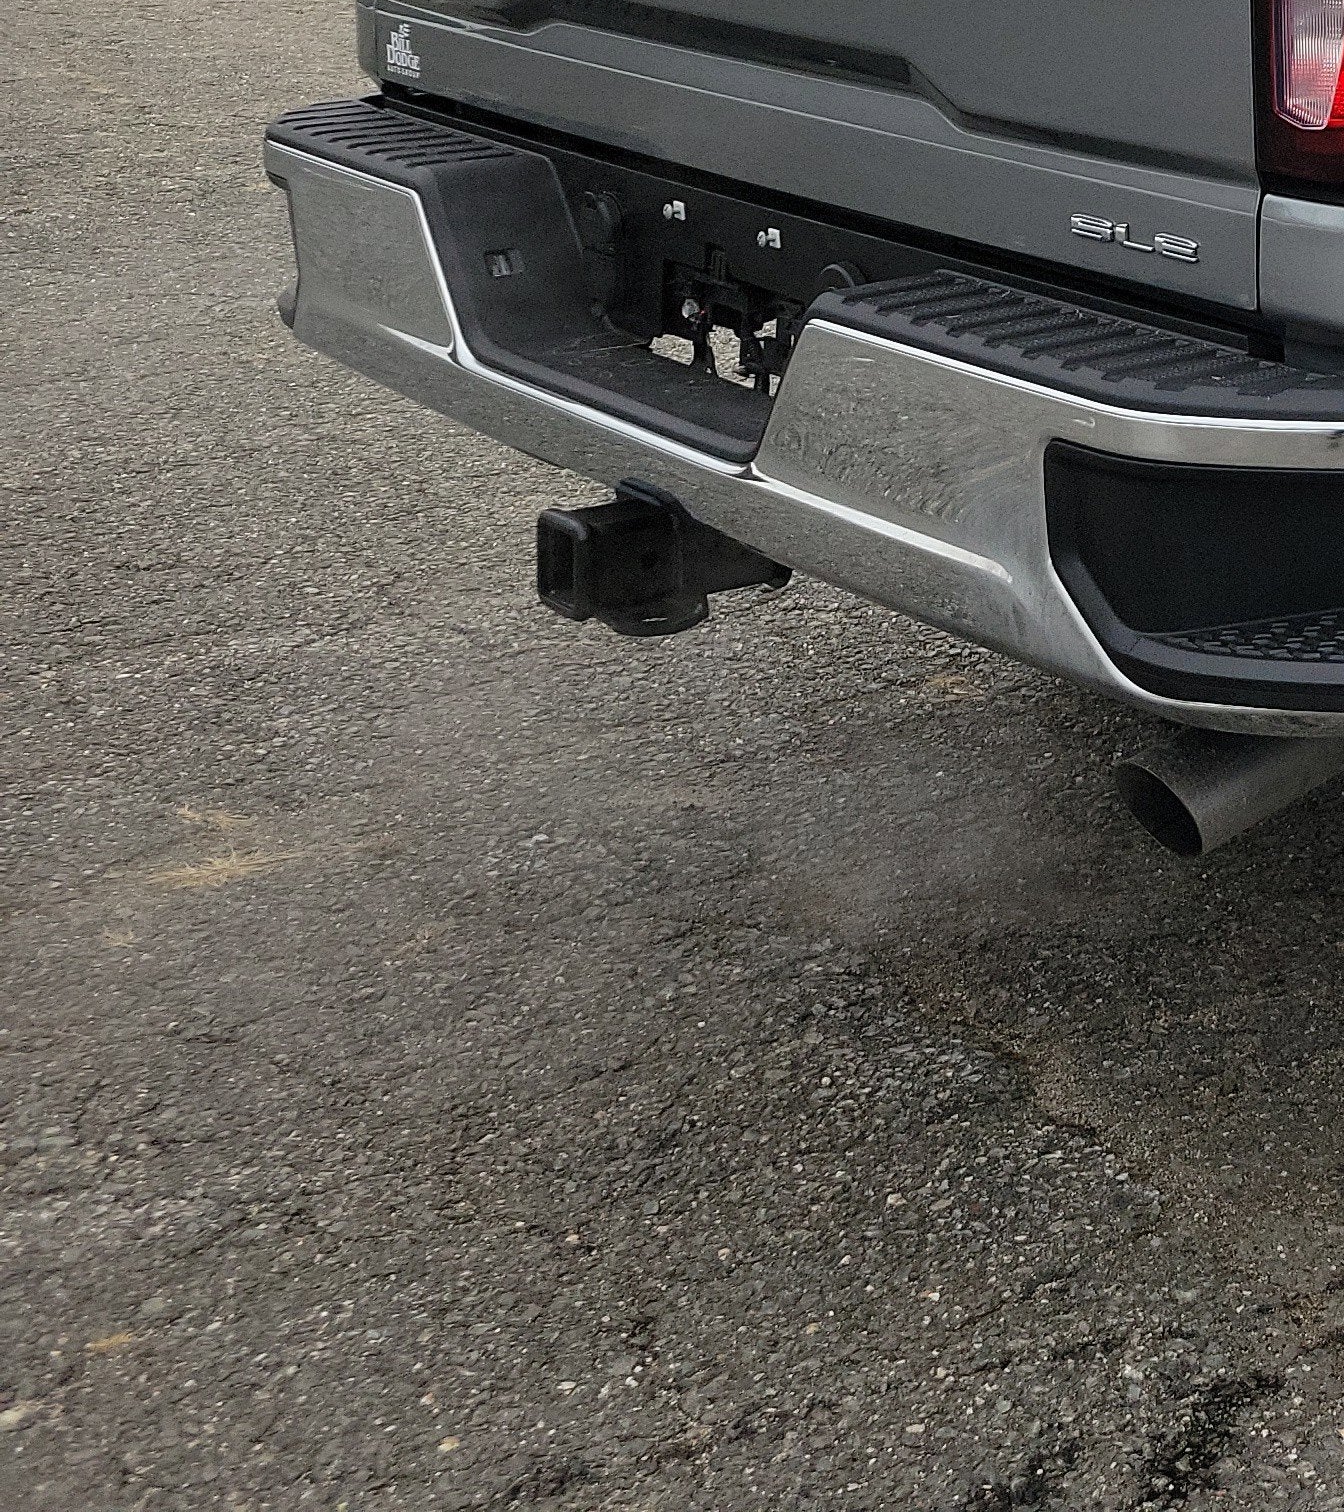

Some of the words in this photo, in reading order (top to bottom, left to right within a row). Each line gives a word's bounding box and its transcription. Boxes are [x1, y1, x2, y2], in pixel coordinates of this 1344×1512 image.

[390, 31, 411, 54] BILL
[386, 44, 420, 70] DODGE
[1070, 213, 1200, 263] SLE
